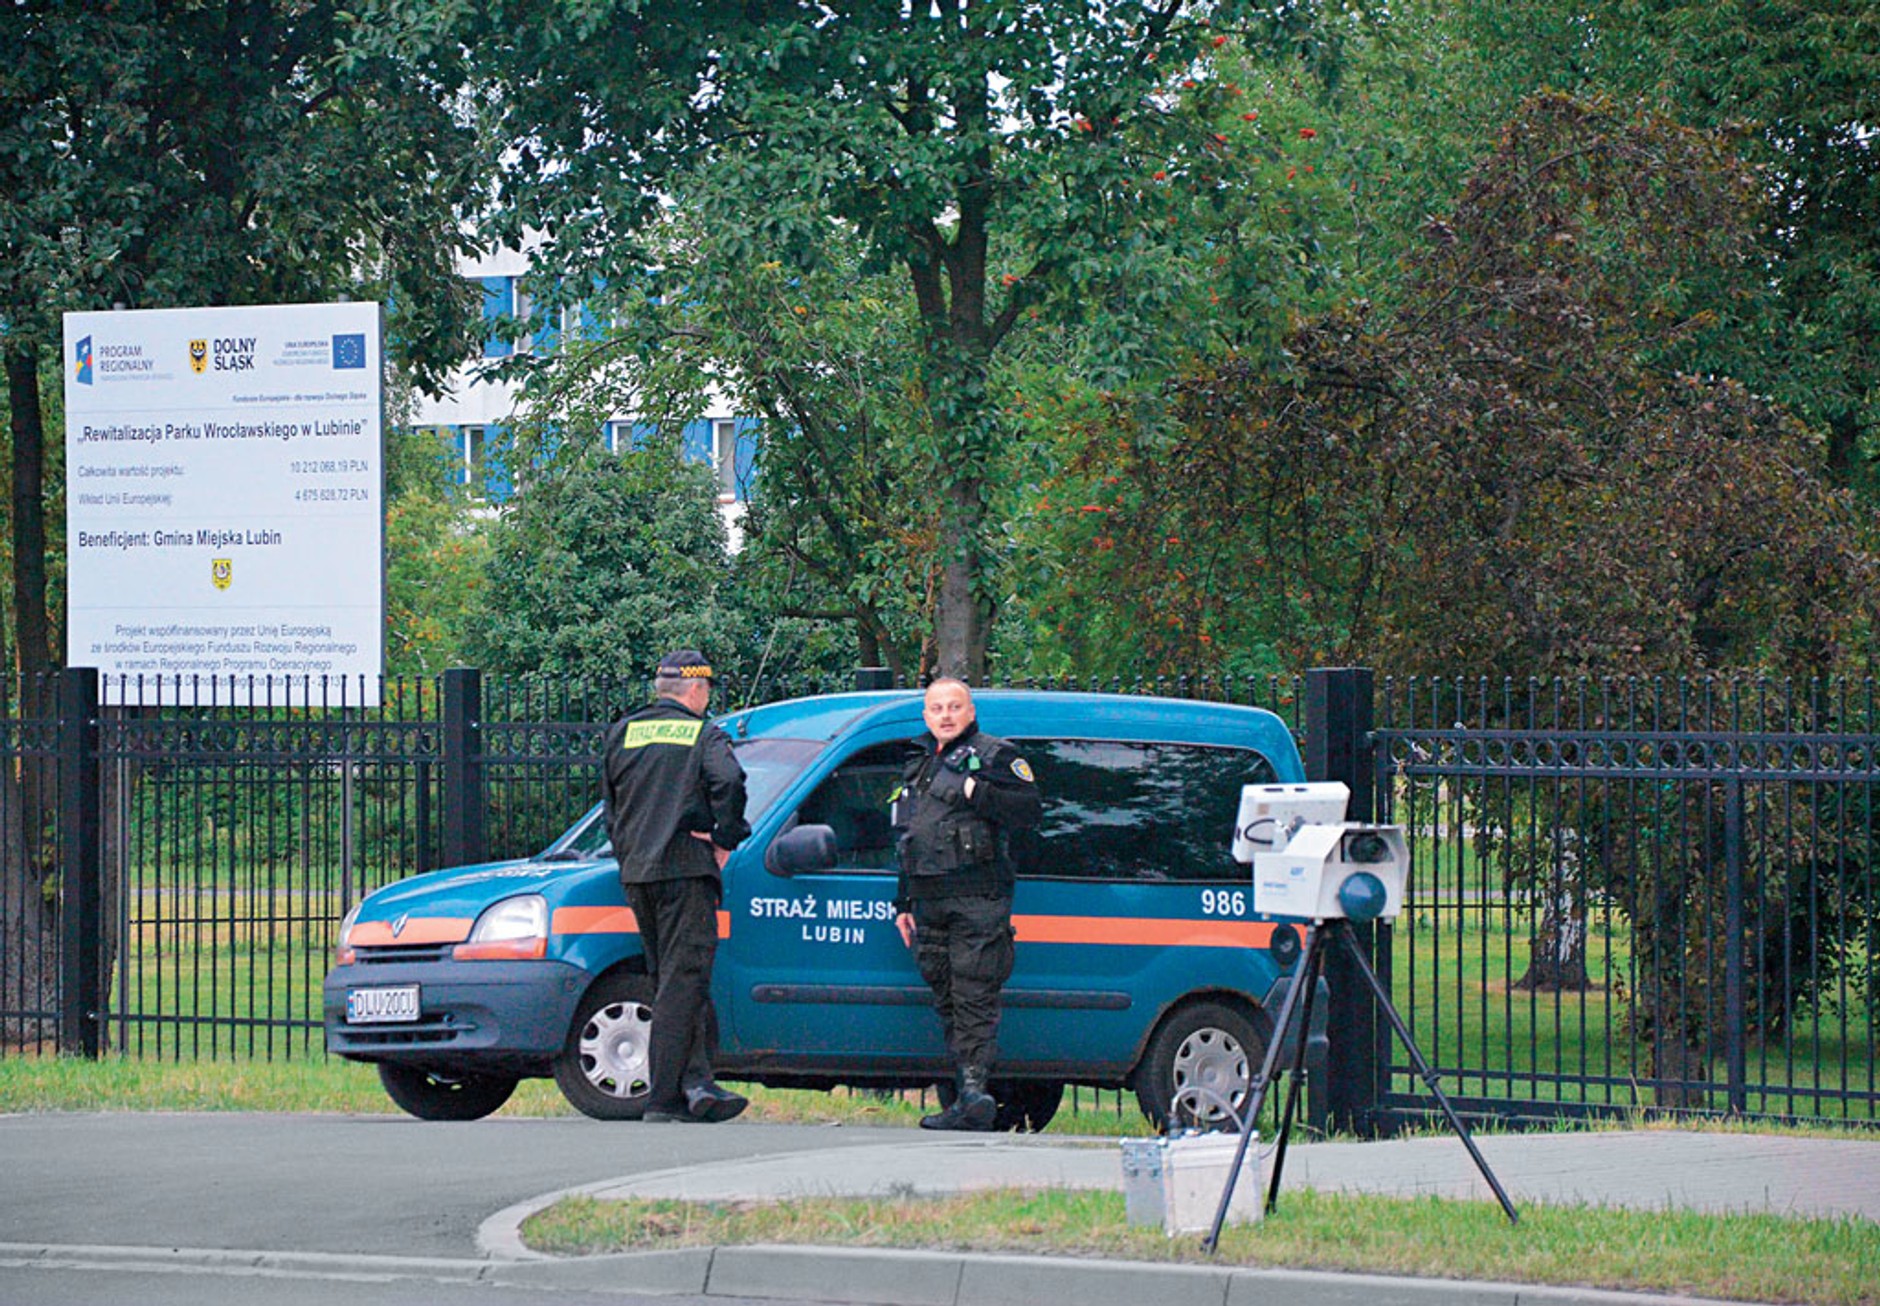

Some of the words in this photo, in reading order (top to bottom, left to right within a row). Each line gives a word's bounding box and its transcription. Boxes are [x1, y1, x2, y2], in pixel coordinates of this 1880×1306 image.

[100, 345, 143, 357] PROGRAM
[214, 338, 257, 354] DOLNY
[100, 360, 154, 373] REGIONALNY
[214, 353, 255, 373] ŚLĄSK
[165, 423, 201, 439] Parku
[204, 421, 298, 441] Wrocławskiego
[301, 424, 312, 436] w
[302, 460, 318, 473] 212
[350, 459, 368, 472] PLN
[295, 489, 301, 501] 4
[350, 488, 368, 501] PLN
[78, 531, 150, 550] Beneficjent:
[154, 530, 193, 547] Gmina
[197, 529, 243, 549] Miejska
[246, 530, 282, 545] Lubin
[115, 624, 146, 638] Projekt
[148, 624, 229, 638] współfinansowany
[231, 626, 255, 638] przez
[91, 643, 101, 653] ze
[143, 641, 205, 655] Europejskiego
[207, 641, 251, 653] Funduszu
[253, 641, 292, 655] Rozwoju
[294, 641, 357, 655] Regionalnego
[115, 660, 122, 668] w
[125, 659, 157, 669] ramach
[160, 658, 221, 671] Regionalnego
[223, 658, 267, 671] Programu
[269, 658, 332, 672] Operacyjnego
[656, 723, 696, 740] MIEJSKA
[750, 894, 817, 919] STRAŻ
[1201, 889, 1246, 916] 986
[802, 924, 865, 944] LUBIN
